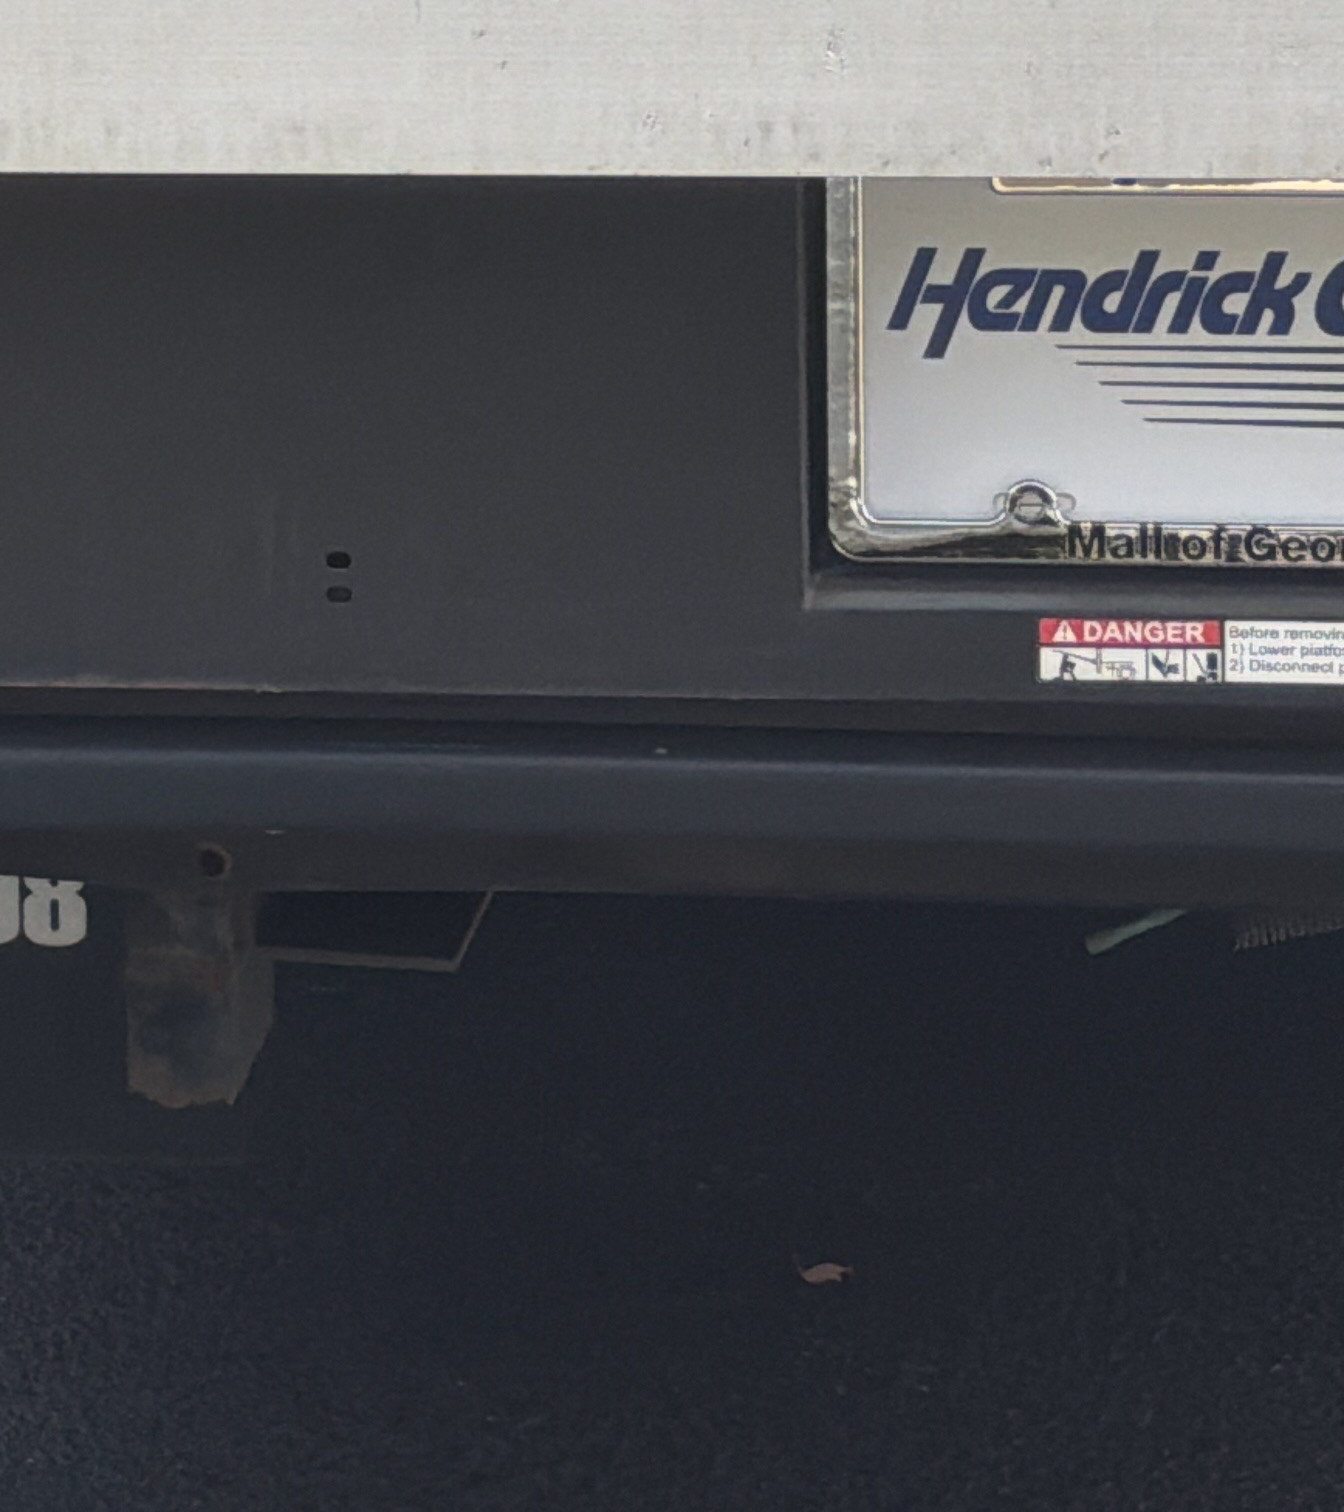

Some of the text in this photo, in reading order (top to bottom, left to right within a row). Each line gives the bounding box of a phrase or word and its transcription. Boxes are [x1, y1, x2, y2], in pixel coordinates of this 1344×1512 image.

[885, 246, 1313, 360] Hendrick
[1067, 522, 1344, 564] Mall of Geo
[1082, 619, 1206, 645] DANGER
[1229, 625, 1280, 640] Before
[1249, 642, 1296, 656] Lower
